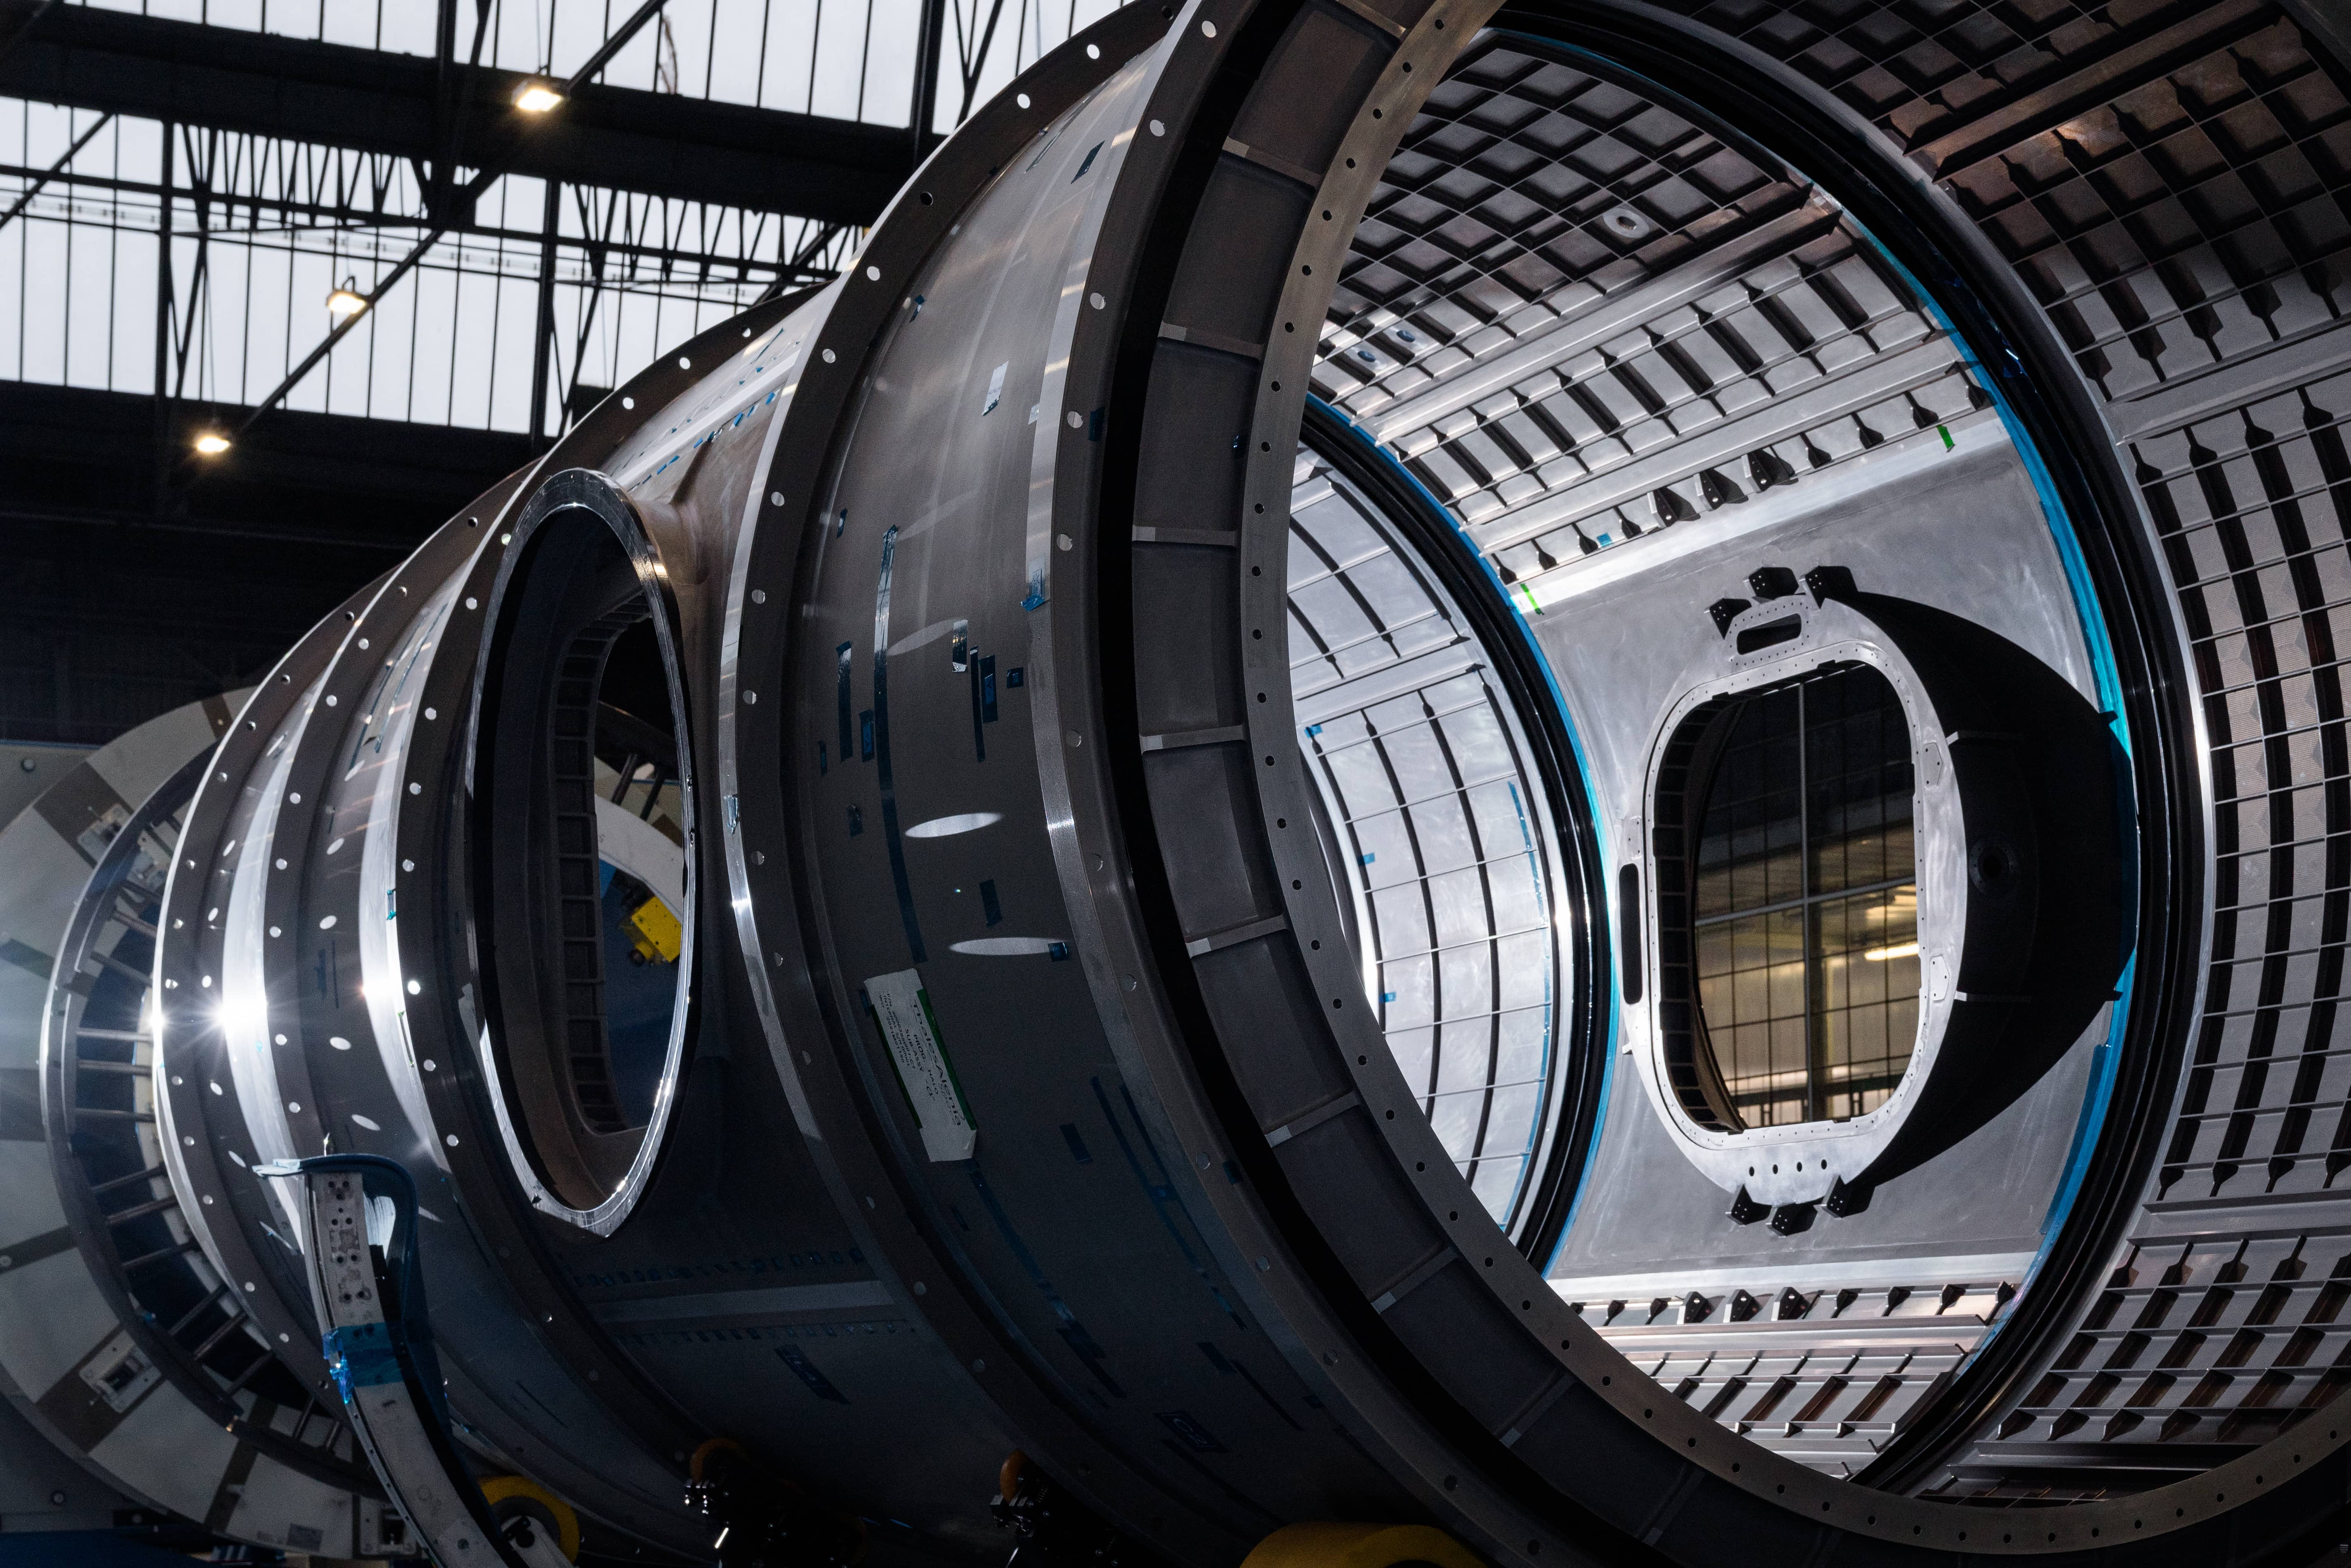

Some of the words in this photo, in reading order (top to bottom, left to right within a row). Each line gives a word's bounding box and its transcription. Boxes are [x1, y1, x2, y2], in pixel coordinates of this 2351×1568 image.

[878, 994, 885, 1008] WO
[883, 995, 897, 1028] INTERNAL
[904, 1029, 924, 1072] SUB-ASSY
[913, 999, 961, 1126] ThalesAlenia
[913, 1034, 927, 1062] PROG.
[927, 1069, 939, 1095] HALO
